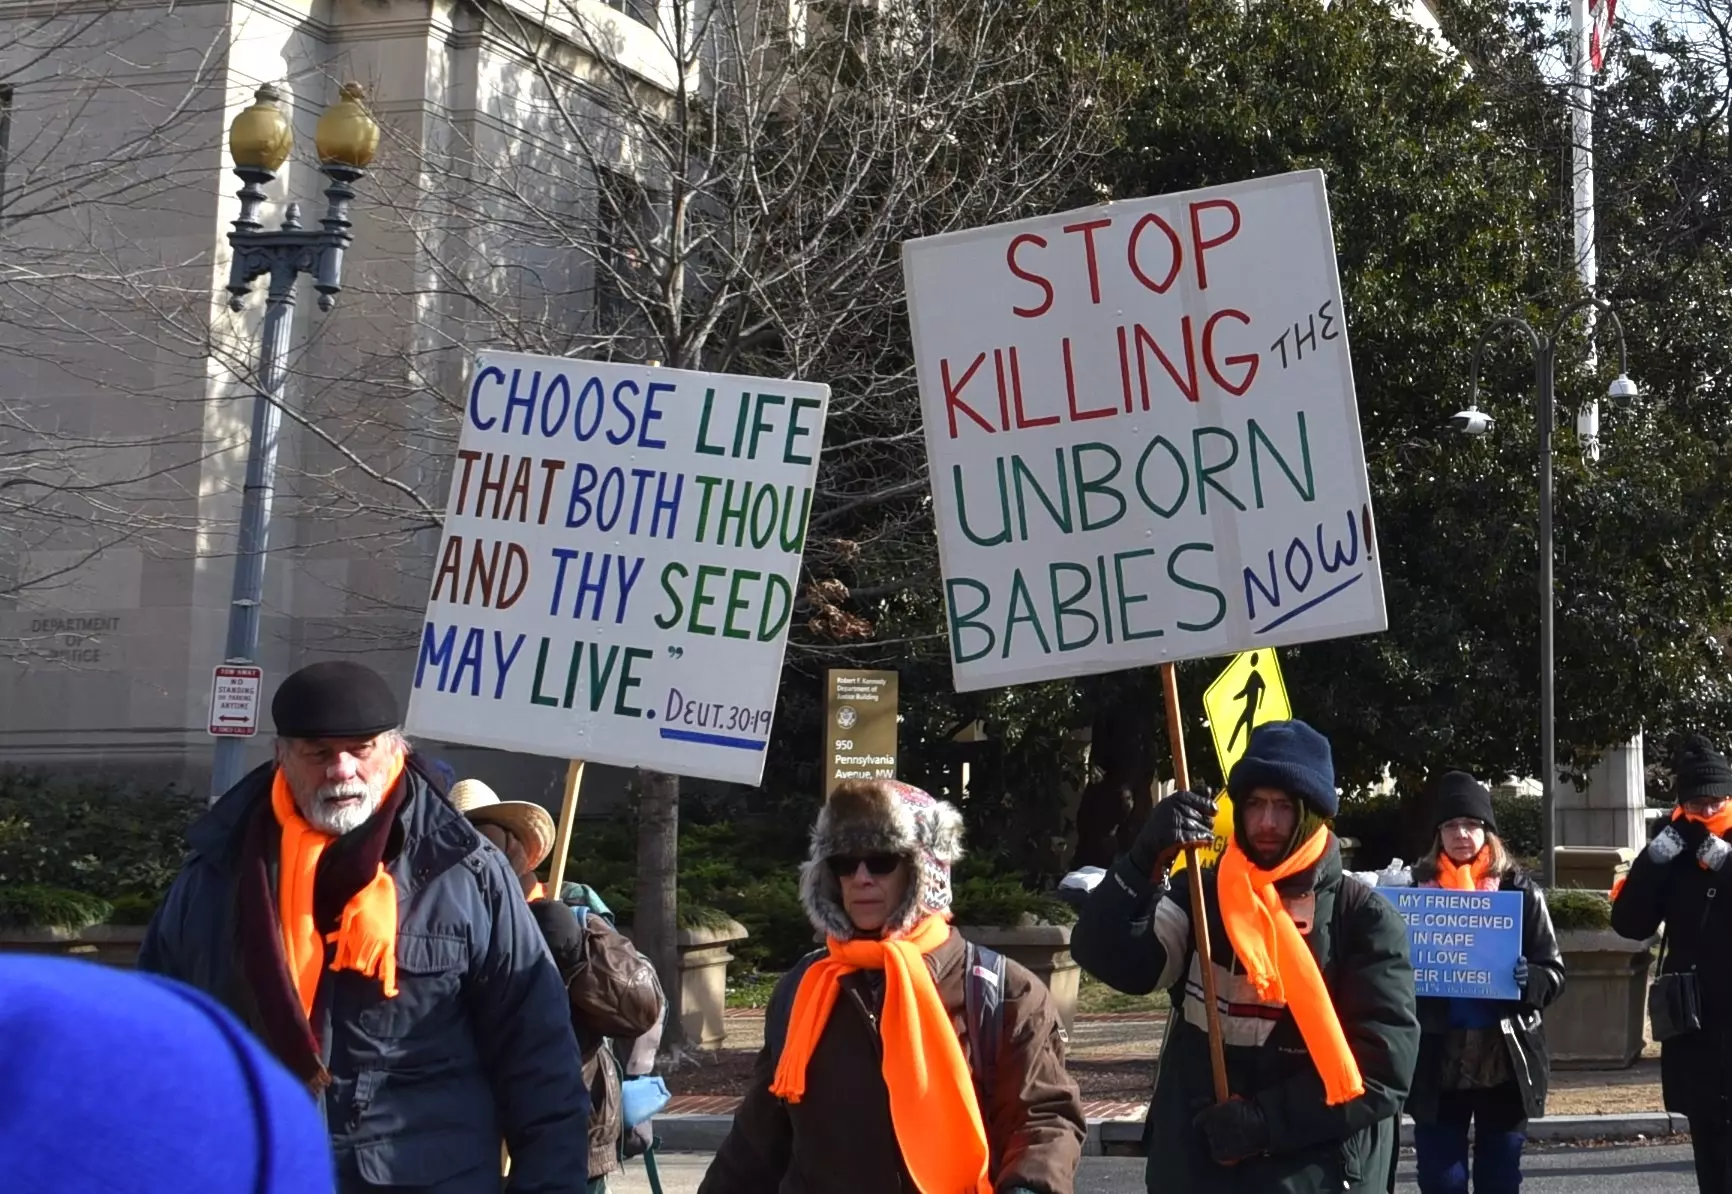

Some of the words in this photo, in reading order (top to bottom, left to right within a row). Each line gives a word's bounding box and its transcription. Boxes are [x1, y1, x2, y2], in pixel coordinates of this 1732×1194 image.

[1006, 199, 1241, 319] STOP
[940, 308, 1260, 439] KILLING
[1270, 300, 1339, 369] THE
[695, 388, 821, 465] LIFE
[952, 411, 1315, 547] UNBORN
[455, 450, 565, 525] THAT
[565, 463, 685, 540] BOTH
[694, 475, 812, 554] THOU
[431, 535, 529, 610] AND
[549, 547, 645, 624] THY
[653, 562, 793, 642] SEED
[946, 542, 1227, 664] BABIES
[1244, 503, 1373, 621] NOW!
[32, 617, 120, 632] DEPARTMENT
[47, 649, 101, 662] USTICE
[413, 621, 526, 700] MAY
[856, 693, 879, 702] Building
[835, 740, 853, 750] 950
[835, 754, 895, 767] Pennsylvania
[835, 769, 873, 780] Avenue,
[875, 769, 894, 779] NW
[1399, 895, 1421, 908] MY
[1425, 896, 1491, 909] FRIENDS
[1401, 914, 1420, 926] RE
[1424, 914, 1513, 929] CONCEIVED
[1413, 932, 1428, 944] IN
[1433, 932, 1474, 946] RAPE
[1418, 951, 1423, 964] I
[1427, 952, 1468, 964] LOVE
[1413, 970, 1439, 982] EIR
[1443, 970, 1491, 984] LIVES!
